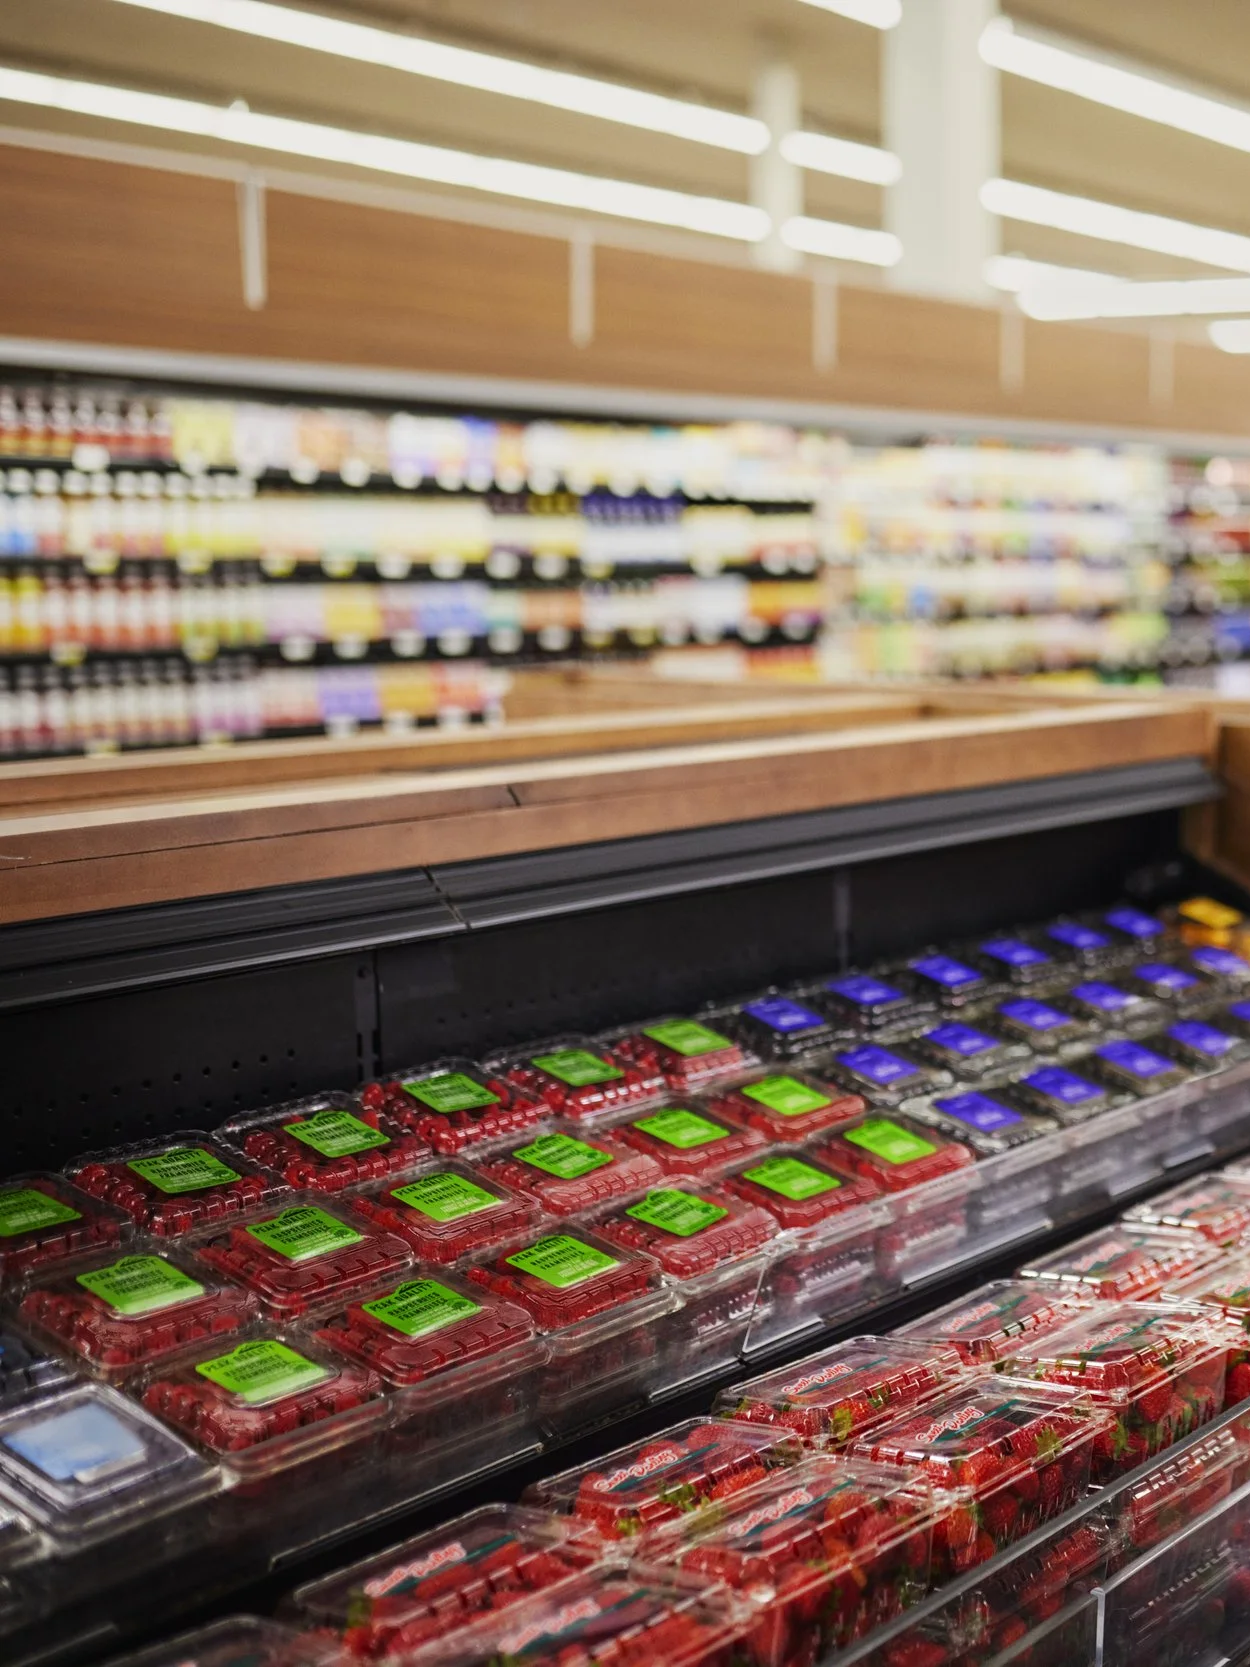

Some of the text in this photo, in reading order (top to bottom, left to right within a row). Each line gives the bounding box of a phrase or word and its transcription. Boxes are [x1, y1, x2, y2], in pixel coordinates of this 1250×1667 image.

[134, 1151, 201, 1168] PEAK QUALITY
[396, 1175, 453, 1196] PEAK QUALITY
[252, 1209, 317, 1234] PEAK QUALITY
[270, 1219, 324, 1239] RASPBERRIES
[280, 1225, 331, 1244] FRAMBOISES
[511, 1238, 568, 1263] PEAK QUALITY
[369, 1282, 433, 1312] PEAK QUALITY
[387, 1292, 441, 1316] RASPBERRIES
[397, 1298, 448, 1321] FRAMBOISES
[233, 1344, 275, 1361] QUALITY
